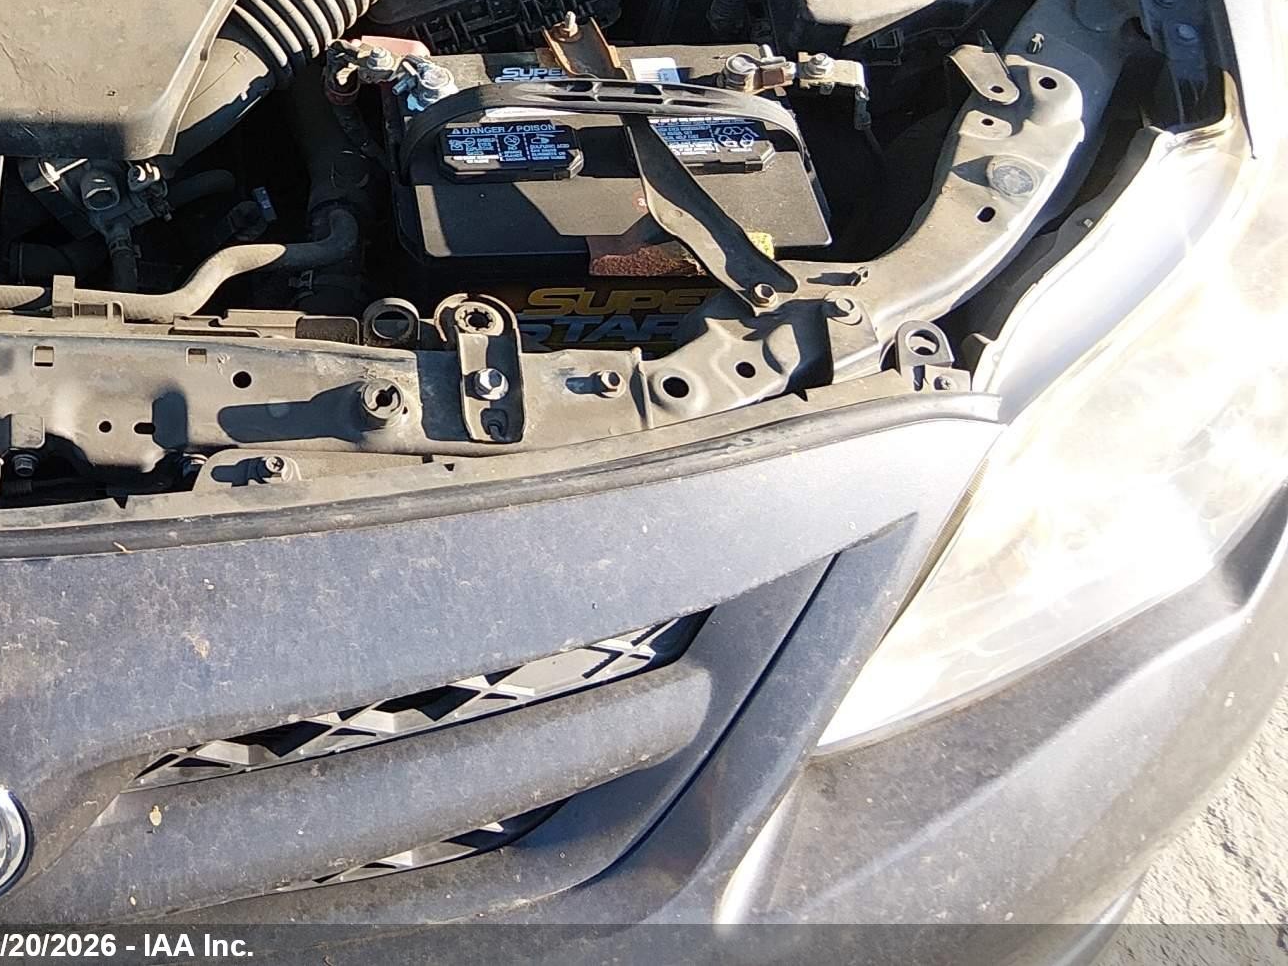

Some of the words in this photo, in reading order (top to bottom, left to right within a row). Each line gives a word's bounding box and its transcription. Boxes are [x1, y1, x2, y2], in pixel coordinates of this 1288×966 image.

[502, 67, 566, 78] SUPE
[462, 126, 506, 134] DANGER
[516, 124, 556, 132] POISON
